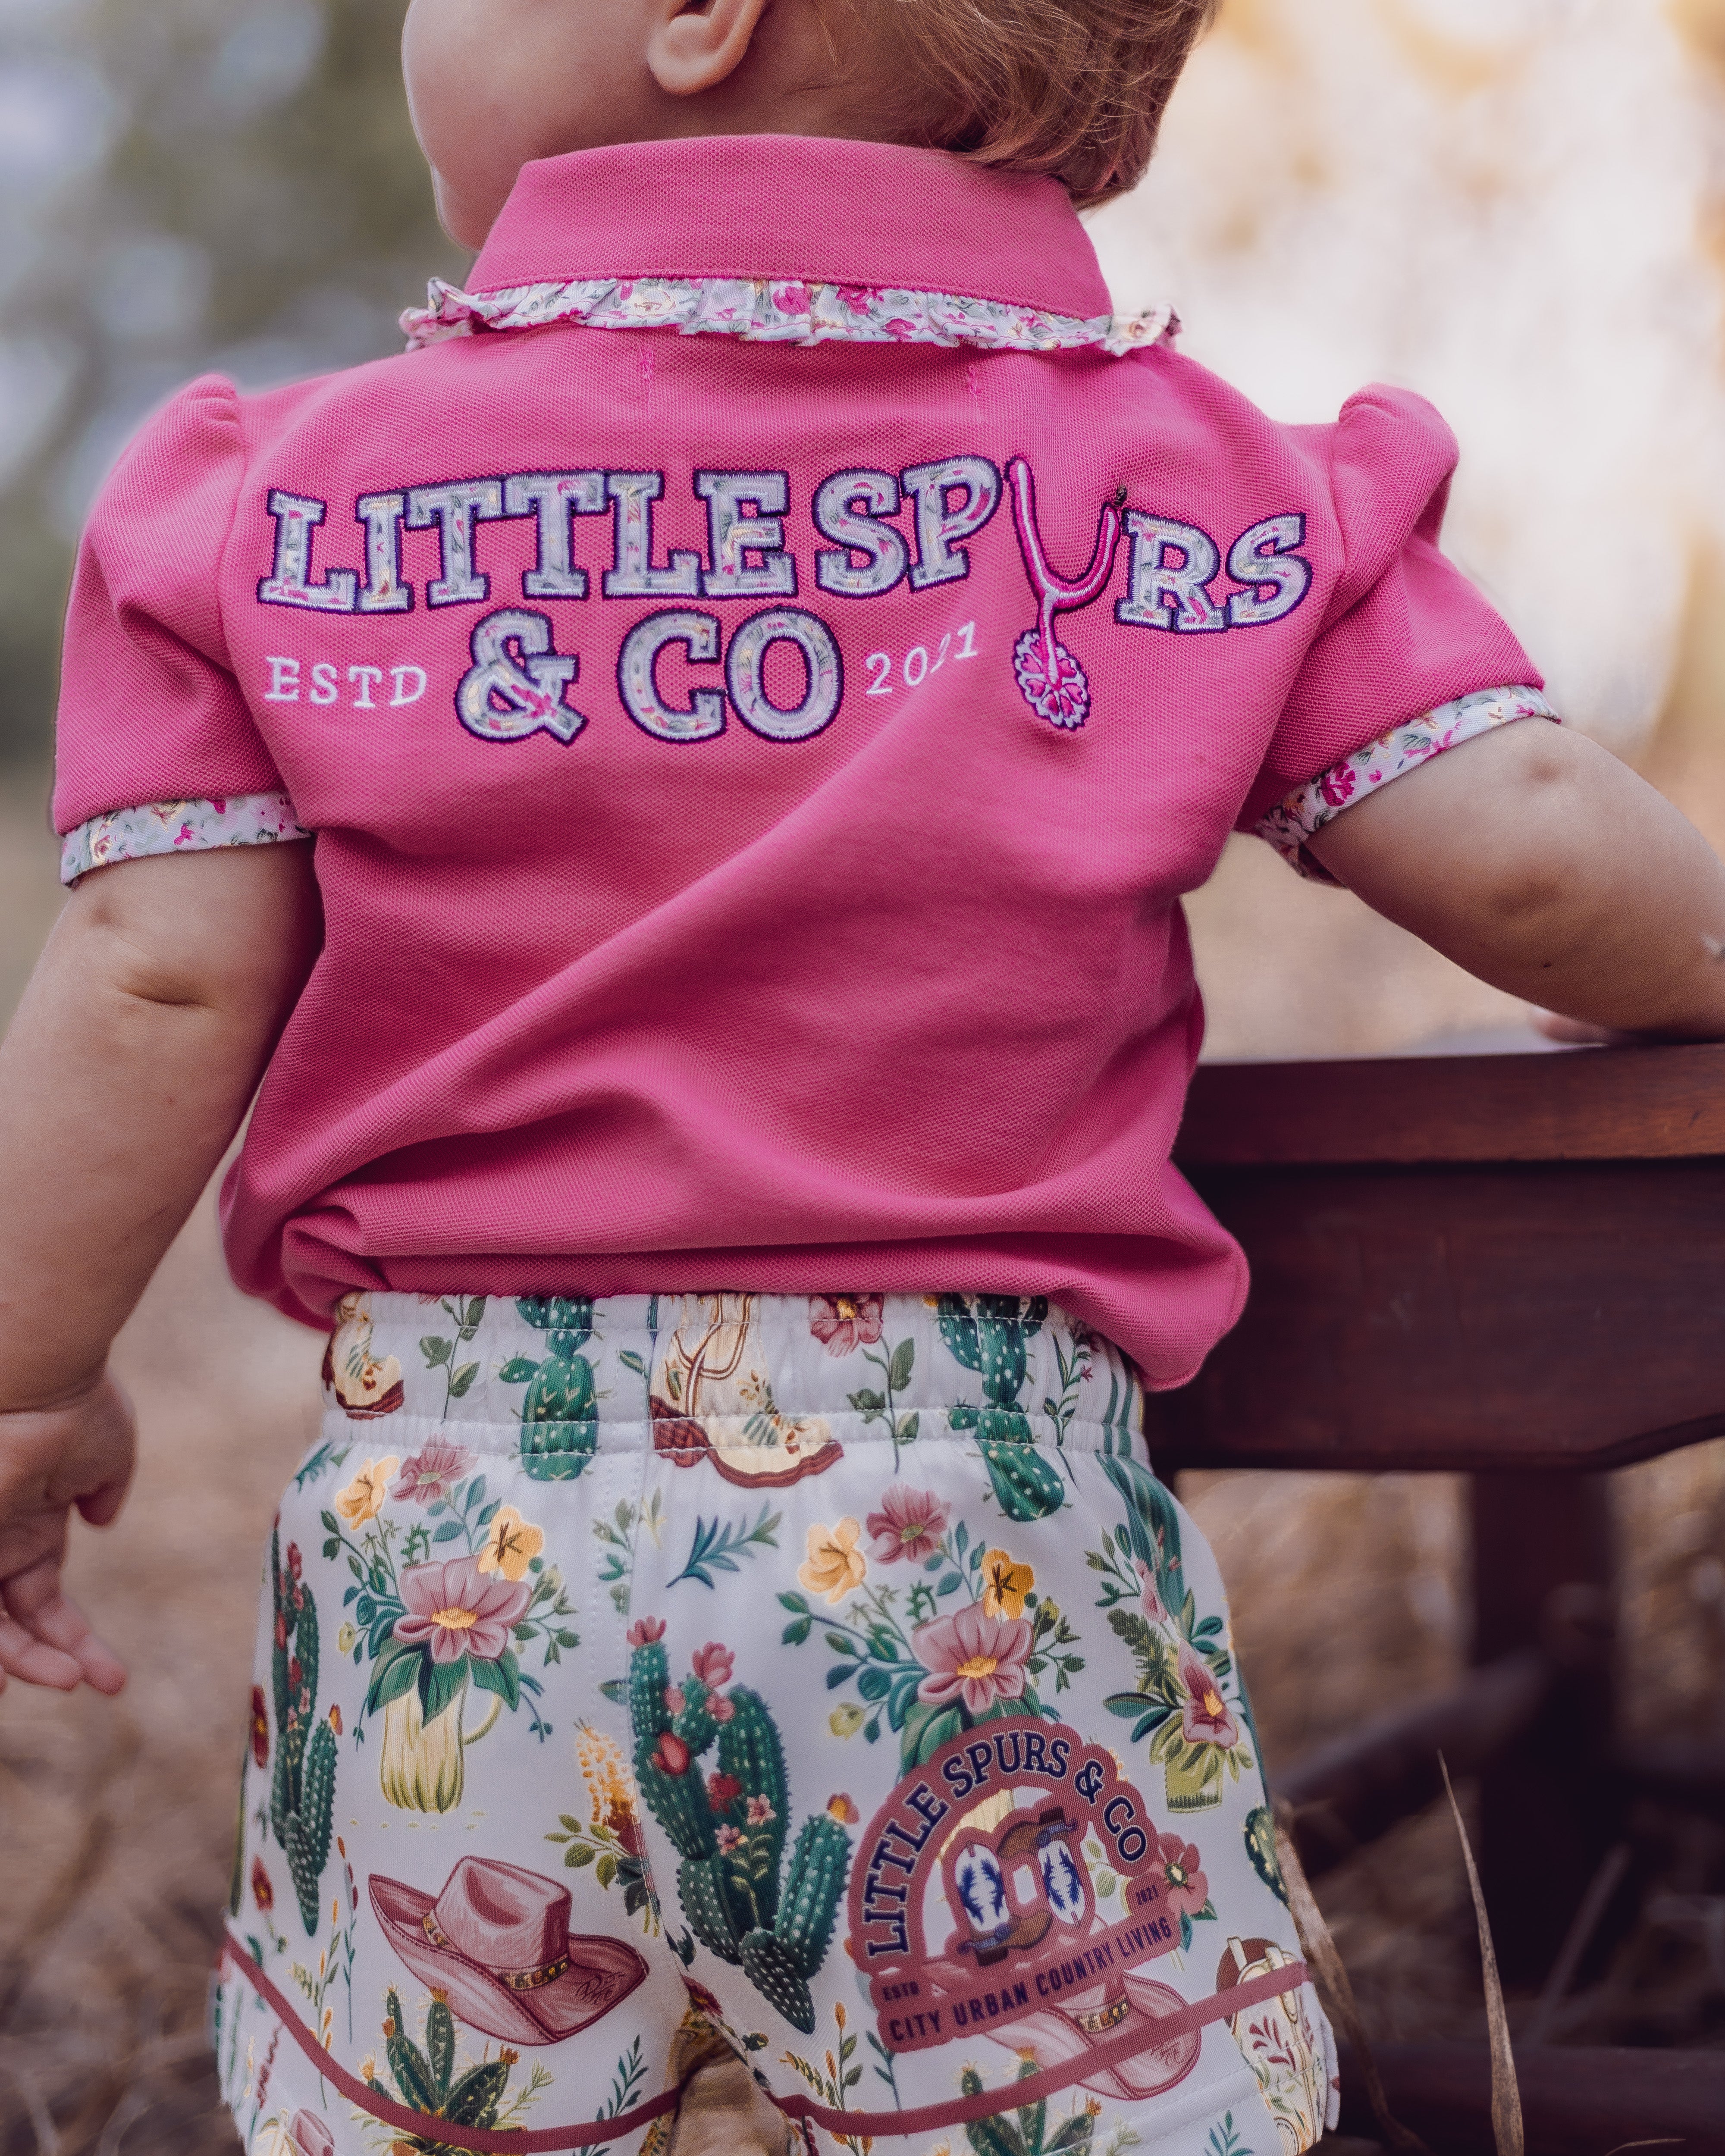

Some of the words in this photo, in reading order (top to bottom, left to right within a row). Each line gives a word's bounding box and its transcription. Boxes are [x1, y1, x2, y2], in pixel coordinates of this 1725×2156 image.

[265, 655, 427, 709] ESTD
[454, 608, 589, 746] &
[617, 605, 844, 744] CO
[863, 1781, 951, 1958] LITTLE
[941, 1730, 1071, 1799] SPURS
[1074, 1759, 1104, 1805] &
[1103, 1795, 1148, 1864] CO
[889, 2009, 941, 2042] CITY
[951, 1981, 1029, 2027] URBAN
[1036, 1943, 1114, 1996] COUNTRY
[1116, 1916, 1172, 1959] LIVING
